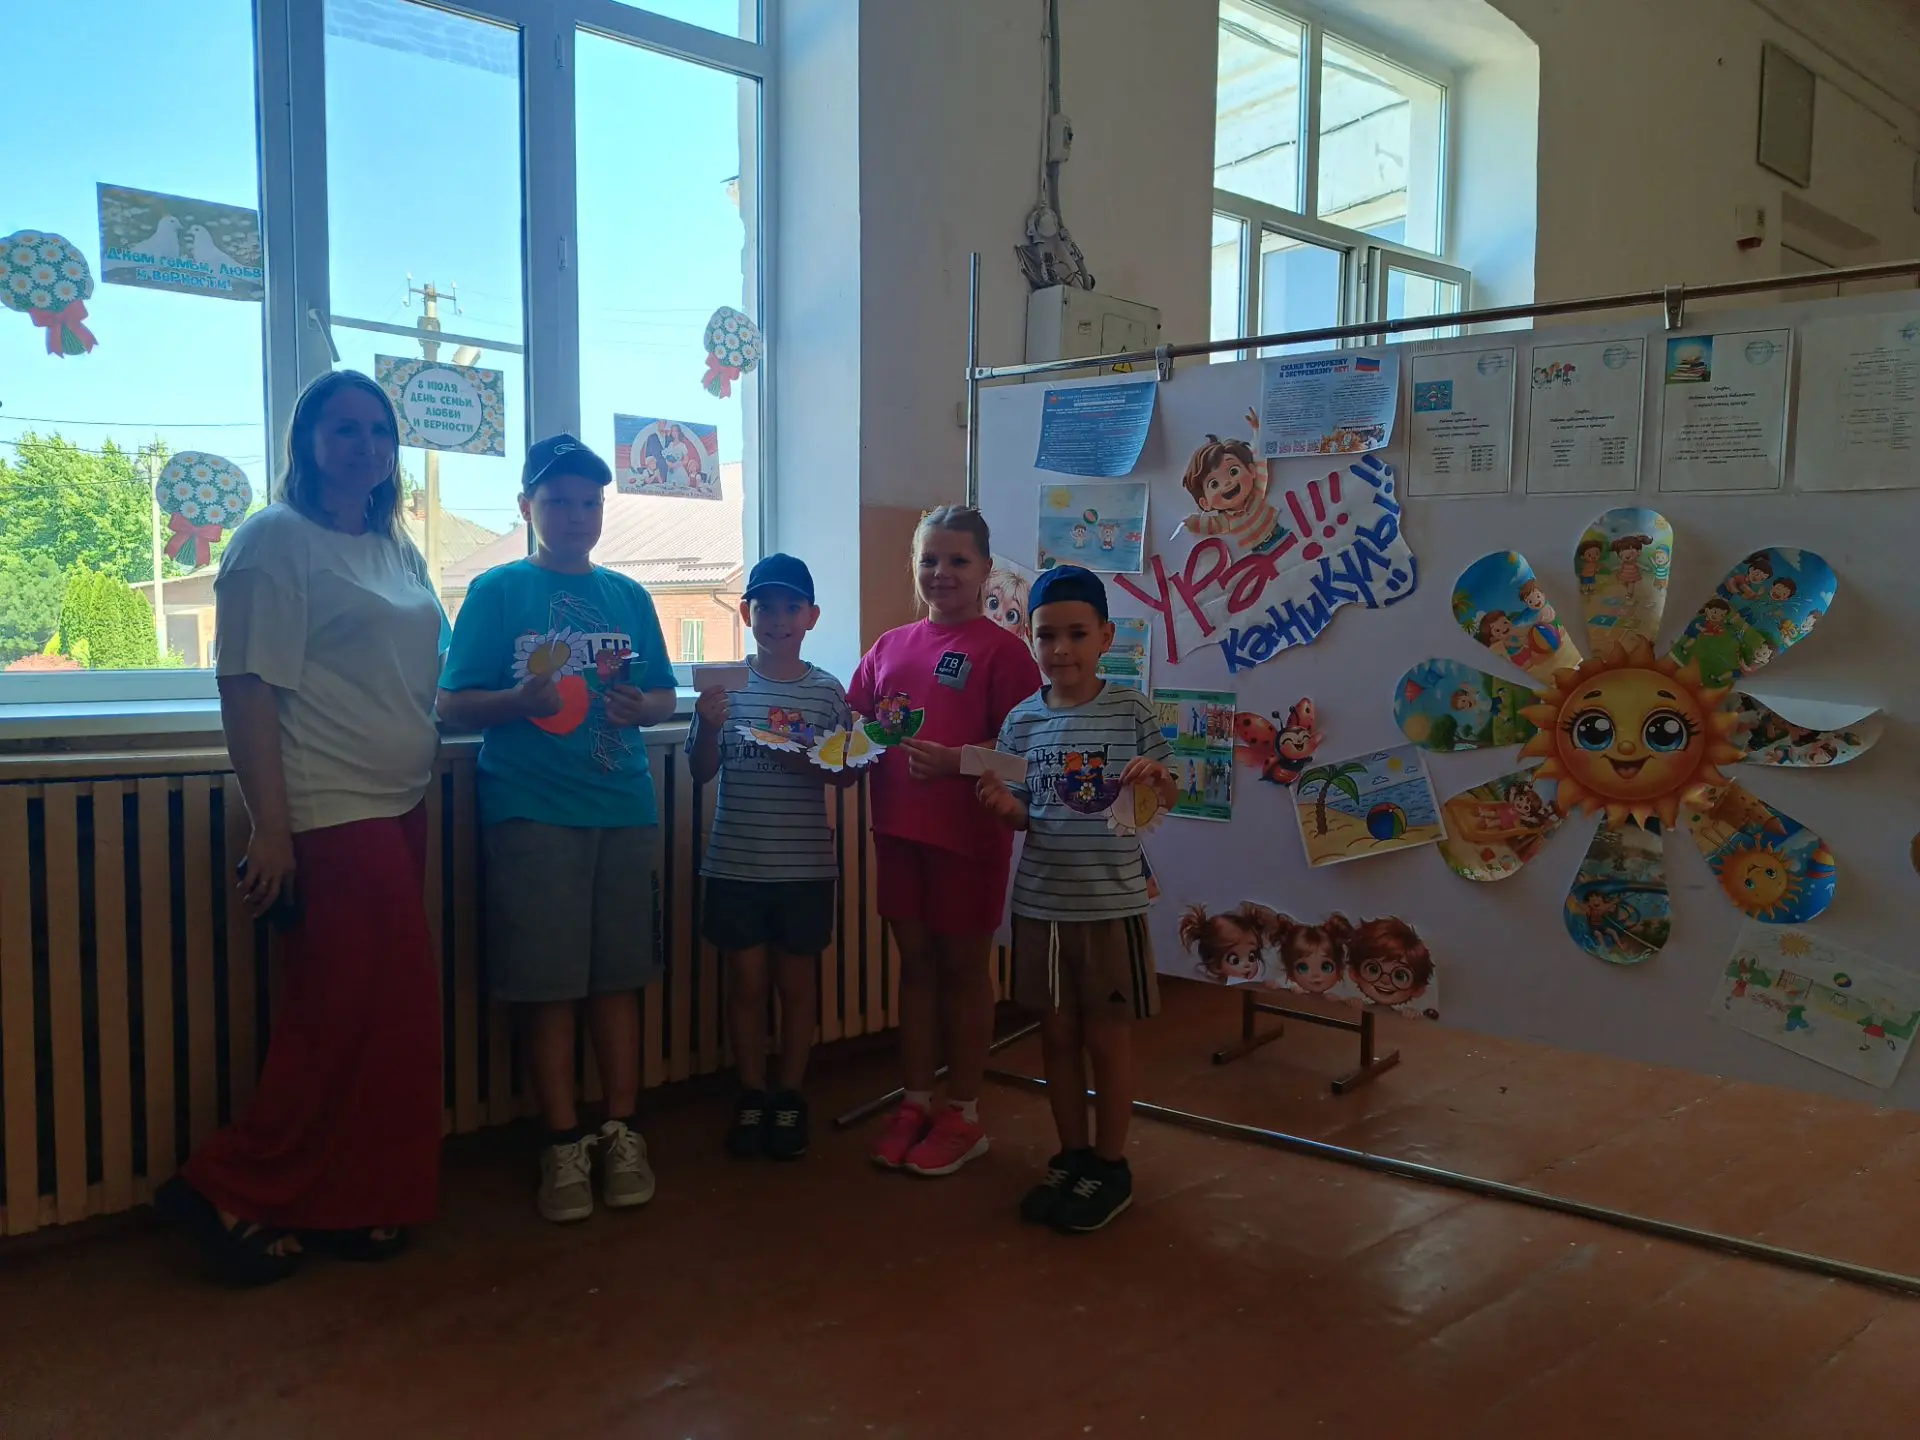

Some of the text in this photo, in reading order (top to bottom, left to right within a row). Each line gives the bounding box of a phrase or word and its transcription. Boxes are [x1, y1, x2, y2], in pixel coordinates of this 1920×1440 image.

[427, 381, 458, 393] ИЮЛЯ
[410, 392, 436, 404] ДЕНЬ
[425, 406, 461, 419] ЛЮБВИ
[413, 417, 474, 433] И ВЕРНОСТИ
[944, 656, 959, 669] TB
